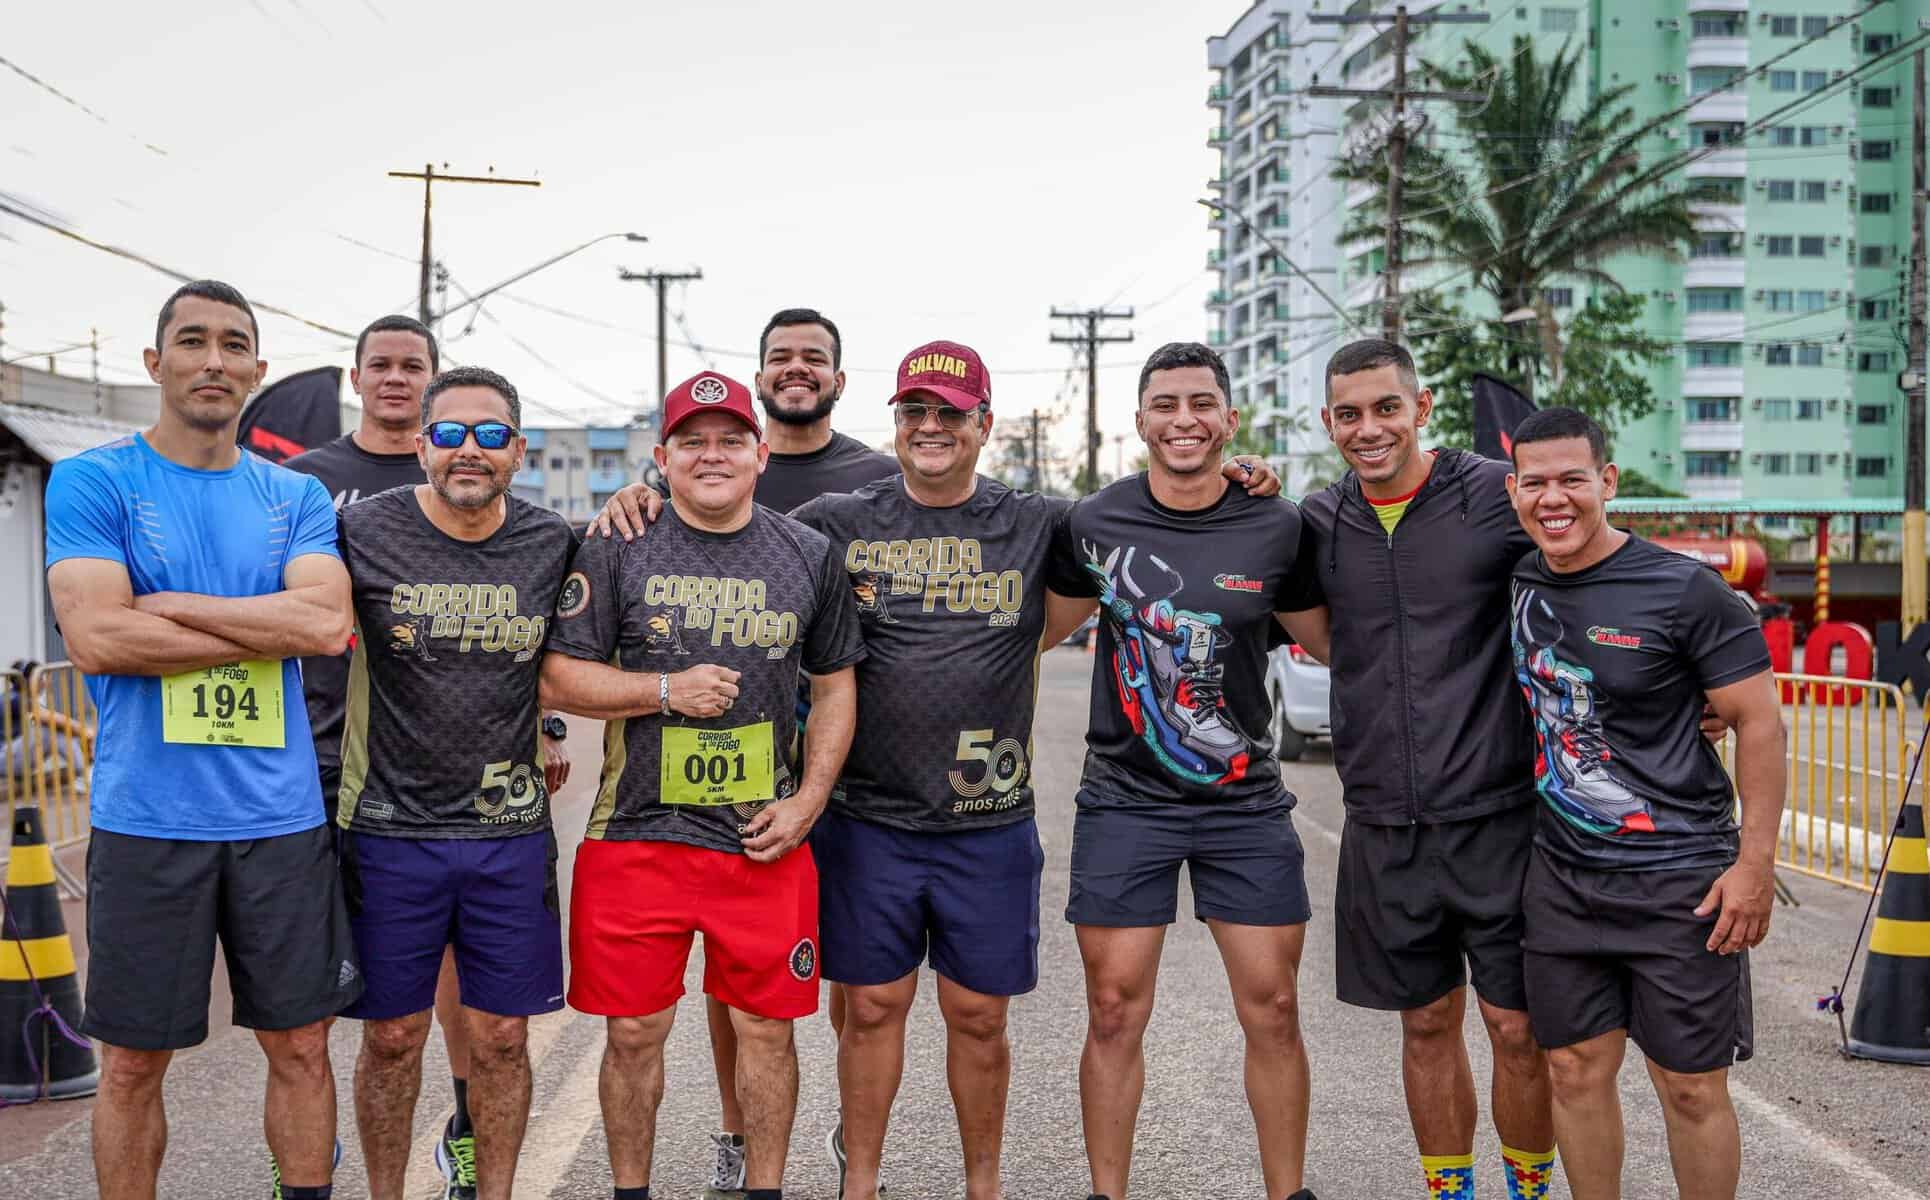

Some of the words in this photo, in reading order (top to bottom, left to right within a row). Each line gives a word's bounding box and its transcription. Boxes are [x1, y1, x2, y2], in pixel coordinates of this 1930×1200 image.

[908, 353, 967, 378] SALVAR
[845, 536, 983, 574] CORRIDA
[391, 583, 517, 617] CORRIDA
[645, 575, 767, 610] CORRIDA
[890, 573, 923, 595] DO
[922, 570, 1023, 613] FOGO
[430, 615, 463, 639] DO
[459, 615, 545, 653] FOGO
[684, 607, 713, 630] DO
[711, 608, 798, 648] FOGO
[988, 612, 1021, 627] 2024
[223, 668, 249, 681] FOGO
[192, 683, 259, 721] 194
[211, 720, 235, 729] 10KM
[697, 731, 732, 740] CORRIDA
[716, 739, 740, 751] FOGO
[684, 752, 748, 785] 001
[706, 785, 725, 793] 5KM
[953, 798, 994, 815] anos
